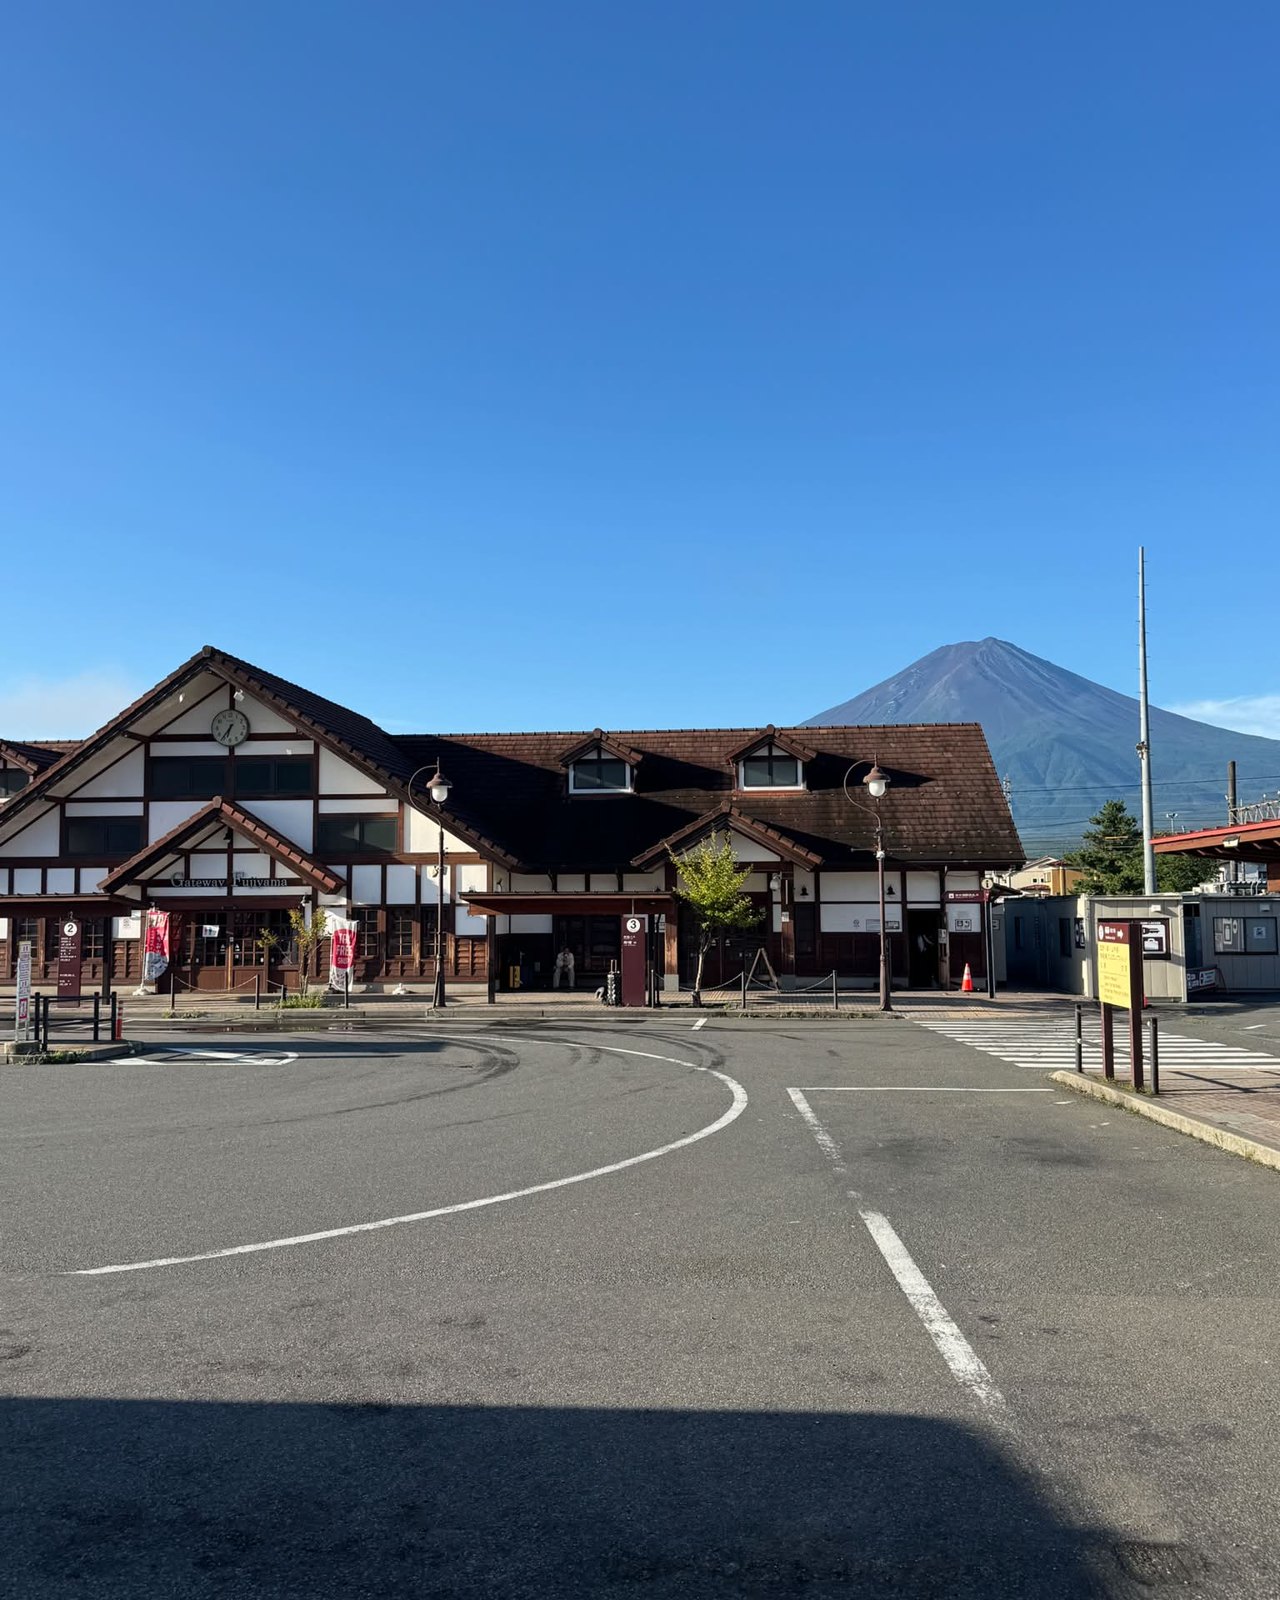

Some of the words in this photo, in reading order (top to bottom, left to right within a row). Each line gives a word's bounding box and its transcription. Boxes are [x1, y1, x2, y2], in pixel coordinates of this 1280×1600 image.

[170, 871, 225, 889] Gateway
[231, 871, 288, 889] Fujiyama
[336, 944, 354, 956] FREE
